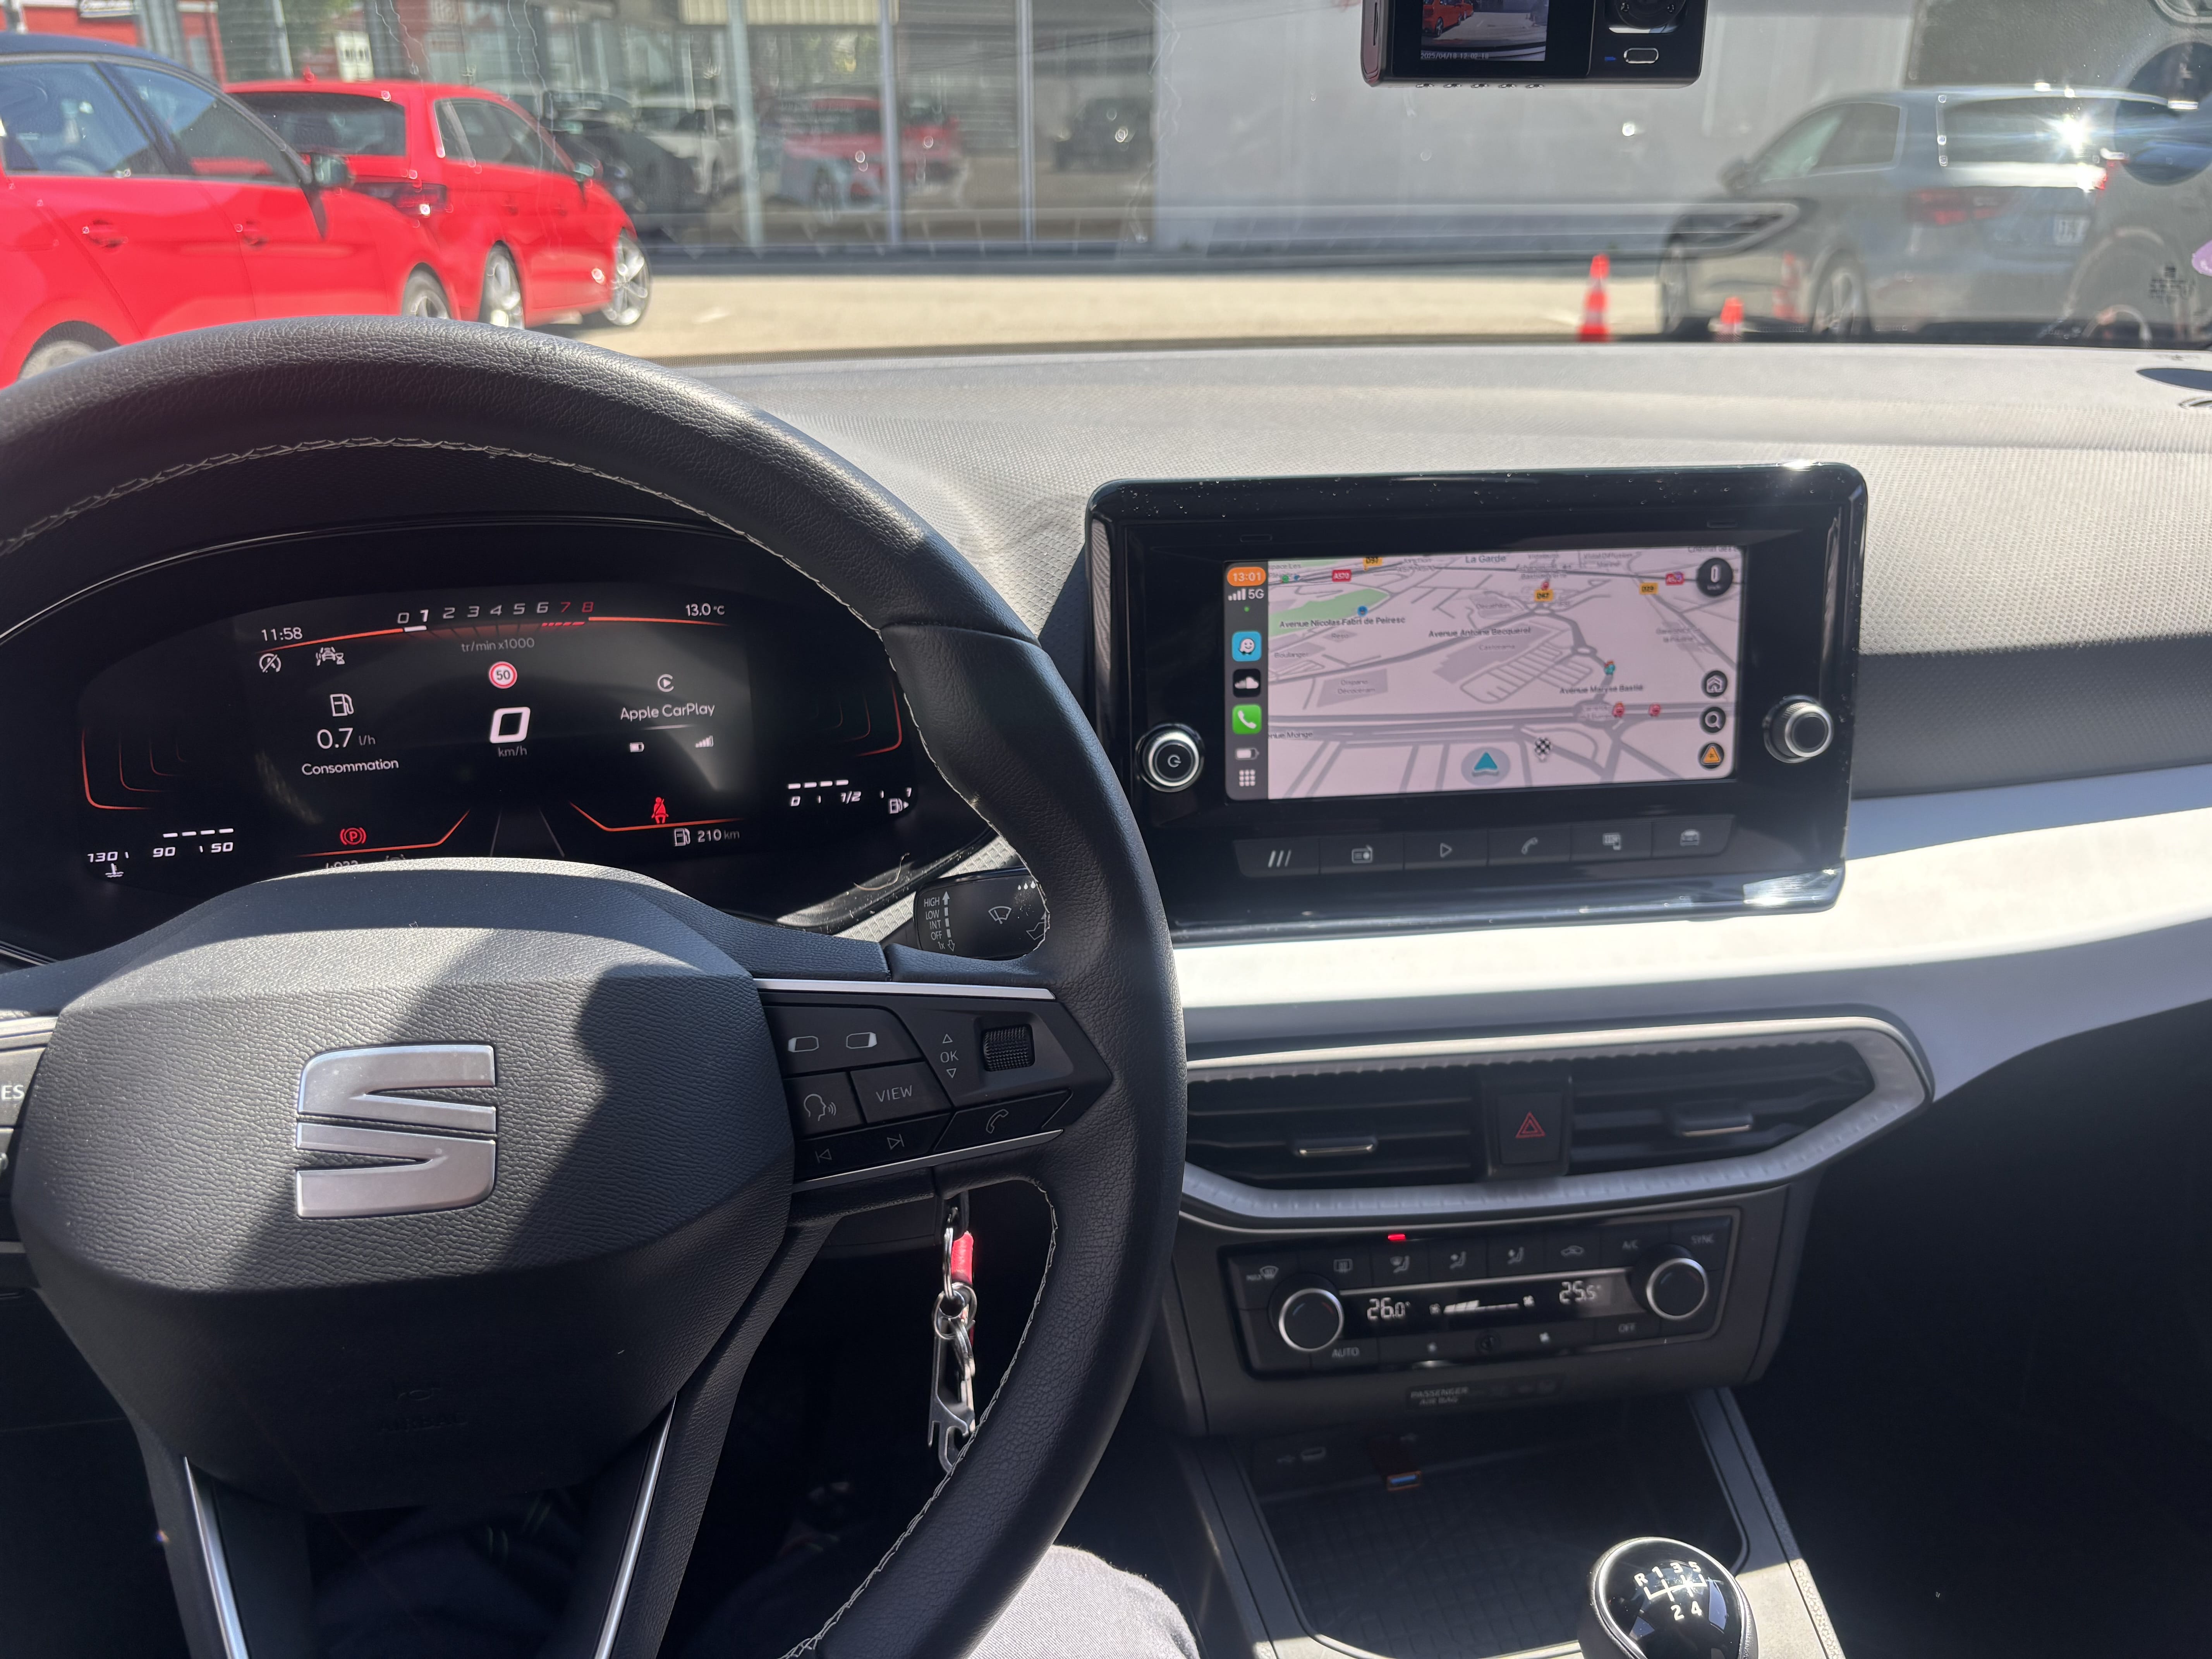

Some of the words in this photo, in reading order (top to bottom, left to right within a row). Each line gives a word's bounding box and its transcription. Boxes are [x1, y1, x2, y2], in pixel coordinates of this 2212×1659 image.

[1233, 572, 1262, 582] 13:01
[1248, 589, 1264, 599] 5G
[397, 613, 409, 623] 0
[419, 610, 429, 622] 1
[443, 608, 456, 618] 2
[467, 606, 479, 617] 3
[490, 605, 502, 616] 4
[513, 603, 526, 615] 5
[537, 602, 549, 614] 6
[560, 602, 570, 613] 7
[581, 601, 594, 613] 8
[686, 603, 710, 617] 13.0
[261, 627, 302, 641] 11:58
[1492, 627, 1530, 636] Becquerel
[461, 641, 496, 653] tr/min
[498, 637, 534, 650] x1000
[496, 670, 510, 680] 50
[620, 706, 659, 721] Apple
[662, 703, 715, 718] CarPlay
[489, 707, 531, 744] 0
[317, 728, 353, 749] 0.7
[498, 745, 527, 757] km/h
[302, 758, 399, 775] Consommation
[841, 791, 861, 804] 1/2
[697, 830, 721, 842] 210
[724, 829, 739, 840] km
[87, 852, 117, 862] 130
[153, 847, 175, 857] 90
[211, 842, 233, 853] 50
[924, 897, 940, 907] HIGH
[926, 910, 939, 920] LOW
[929, 920, 941, 929] INT
[931, 931, 942, 941] OFF
[939, 941, 945, 950] 1x
[940, 1050, 959, 1063] OK
[876, 1085, 913, 1103] VIEW
[1618, 1323, 1637, 1333] OFF
[1332, 1347, 1360, 1358] AUTO
[1411, 1387, 1468, 1398] PASSENGER
[1634, 1573, 1648, 1587] R
[1652, 1566, 1664, 1578] 1
[1670, 1562, 1683, 1573] 3
[1688, 1561, 1701, 1572] 5
[1670, 1604, 1684, 1621] 2
[1691, 1601, 1702, 1616] 4
